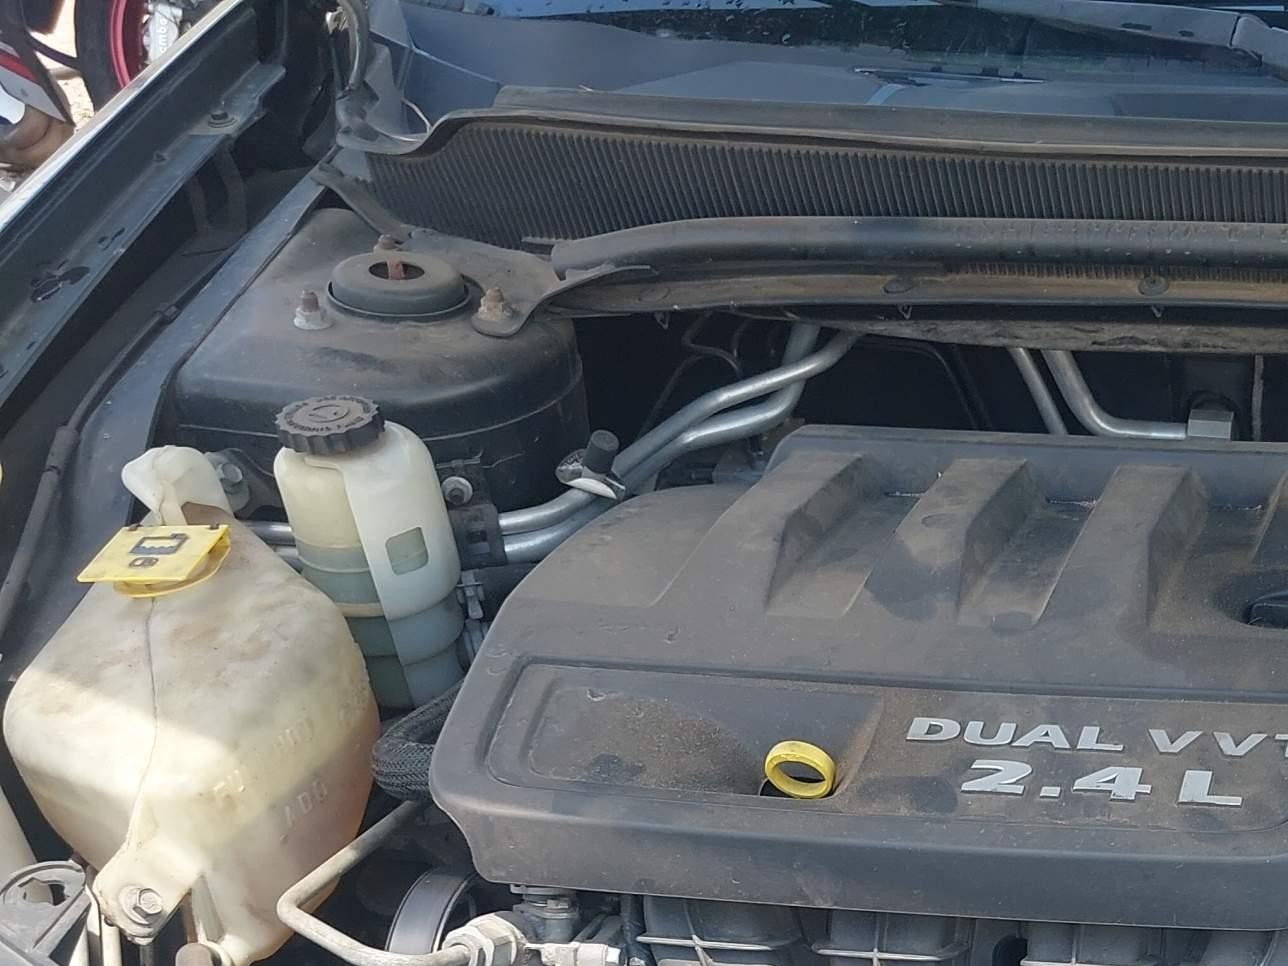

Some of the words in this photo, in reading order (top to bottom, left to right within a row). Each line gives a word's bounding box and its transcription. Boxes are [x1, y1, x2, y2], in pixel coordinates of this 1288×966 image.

[905, 717, 1124, 752] DUAL
[960, 759, 1152, 800] 2.4
[1177, 770, 1243, 807] L
